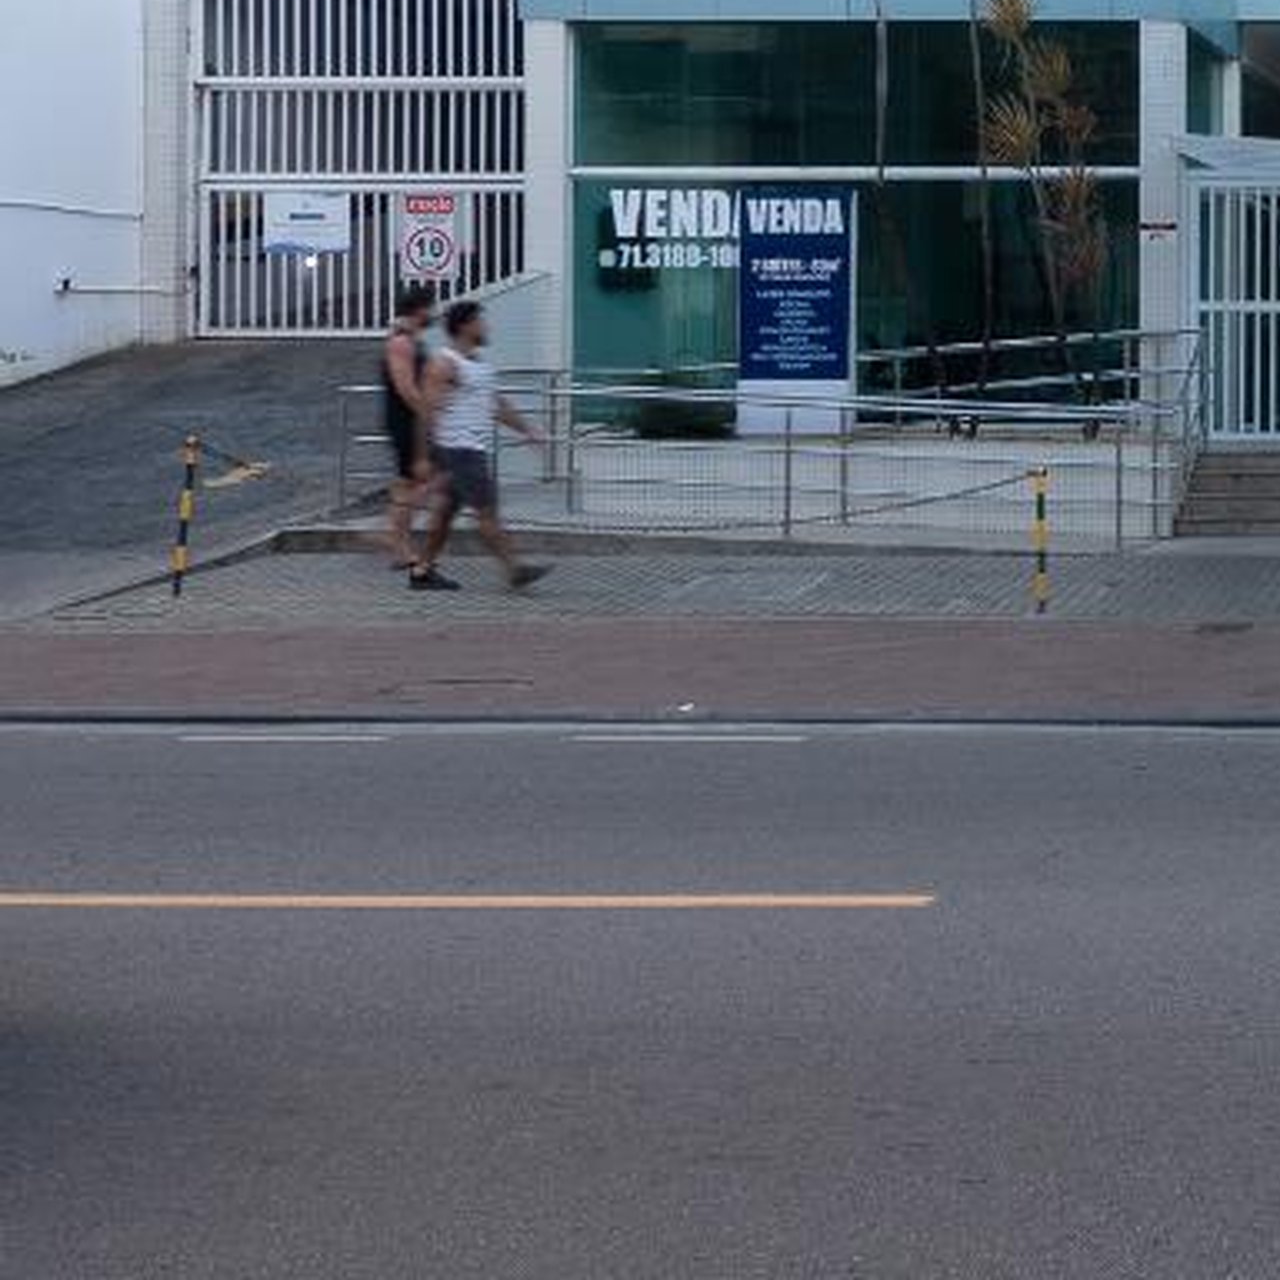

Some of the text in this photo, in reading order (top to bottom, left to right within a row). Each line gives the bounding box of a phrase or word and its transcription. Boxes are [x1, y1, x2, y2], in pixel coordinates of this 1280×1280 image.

[609, 188, 741, 238] VEND
[746, 198, 845, 235] VENDA
[415, 236, 445, 258] 10
